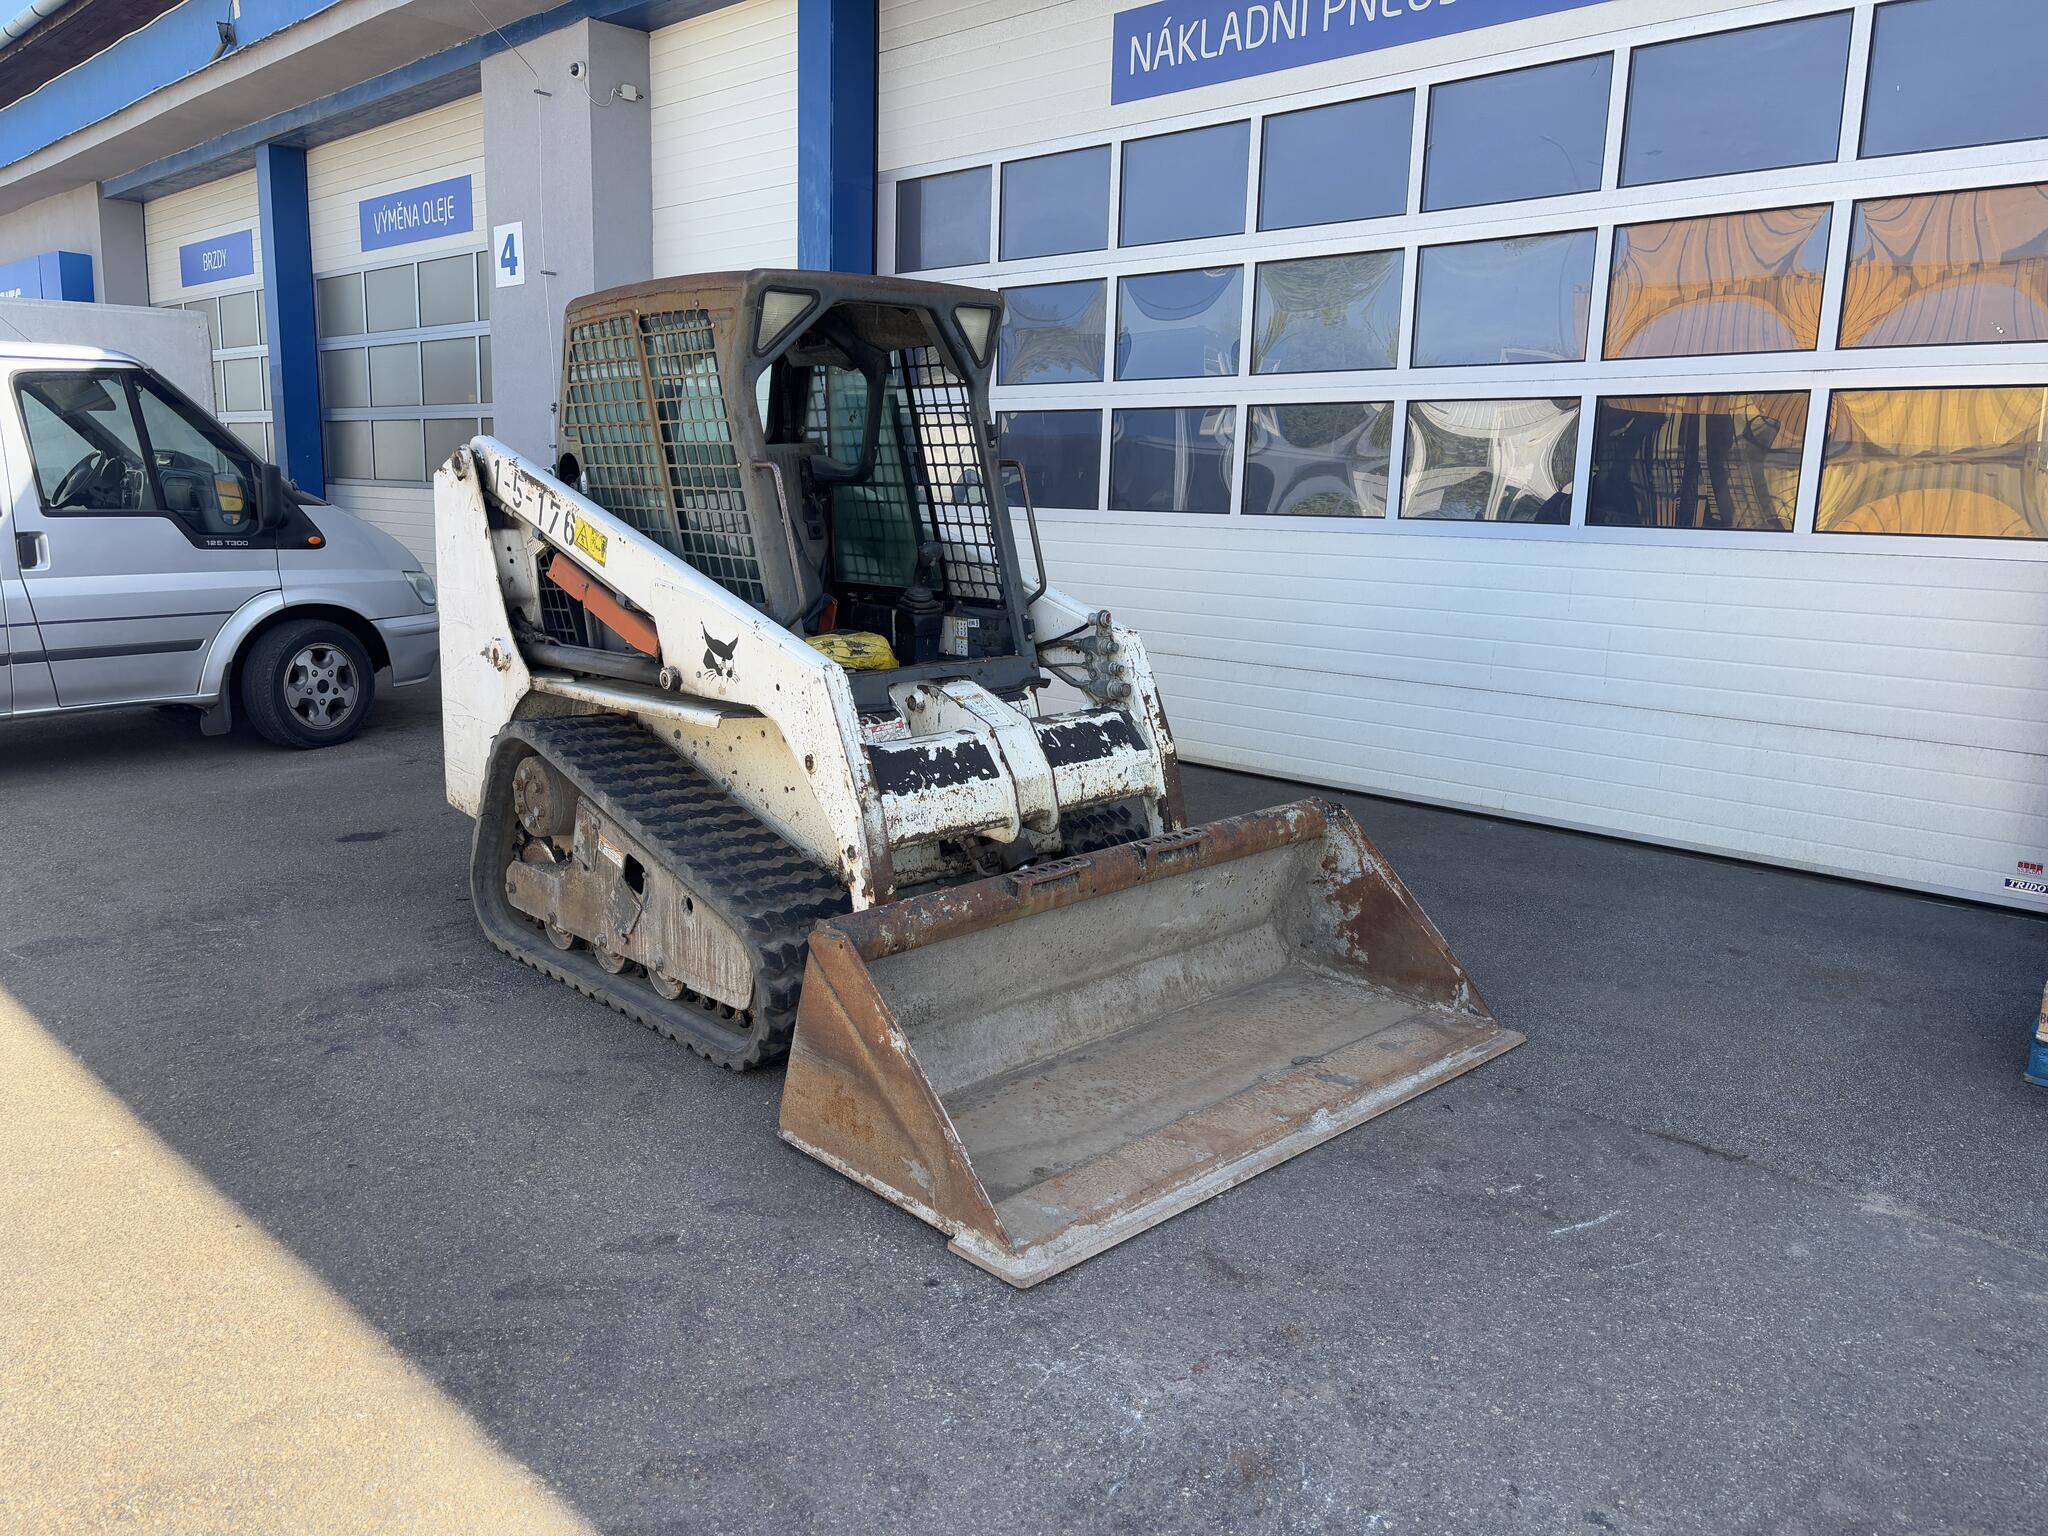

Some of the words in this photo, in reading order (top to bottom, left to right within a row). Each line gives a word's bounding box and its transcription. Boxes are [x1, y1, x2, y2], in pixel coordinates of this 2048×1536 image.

[373, 201, 420, 235] VÝMĚNA
[422, 195, 455, 226] OLEJE
[202, 248, 227, 271] BRZDY
[500, 233, 518, 275] 4
[2009, 879, 2047, 893] TRIDO
